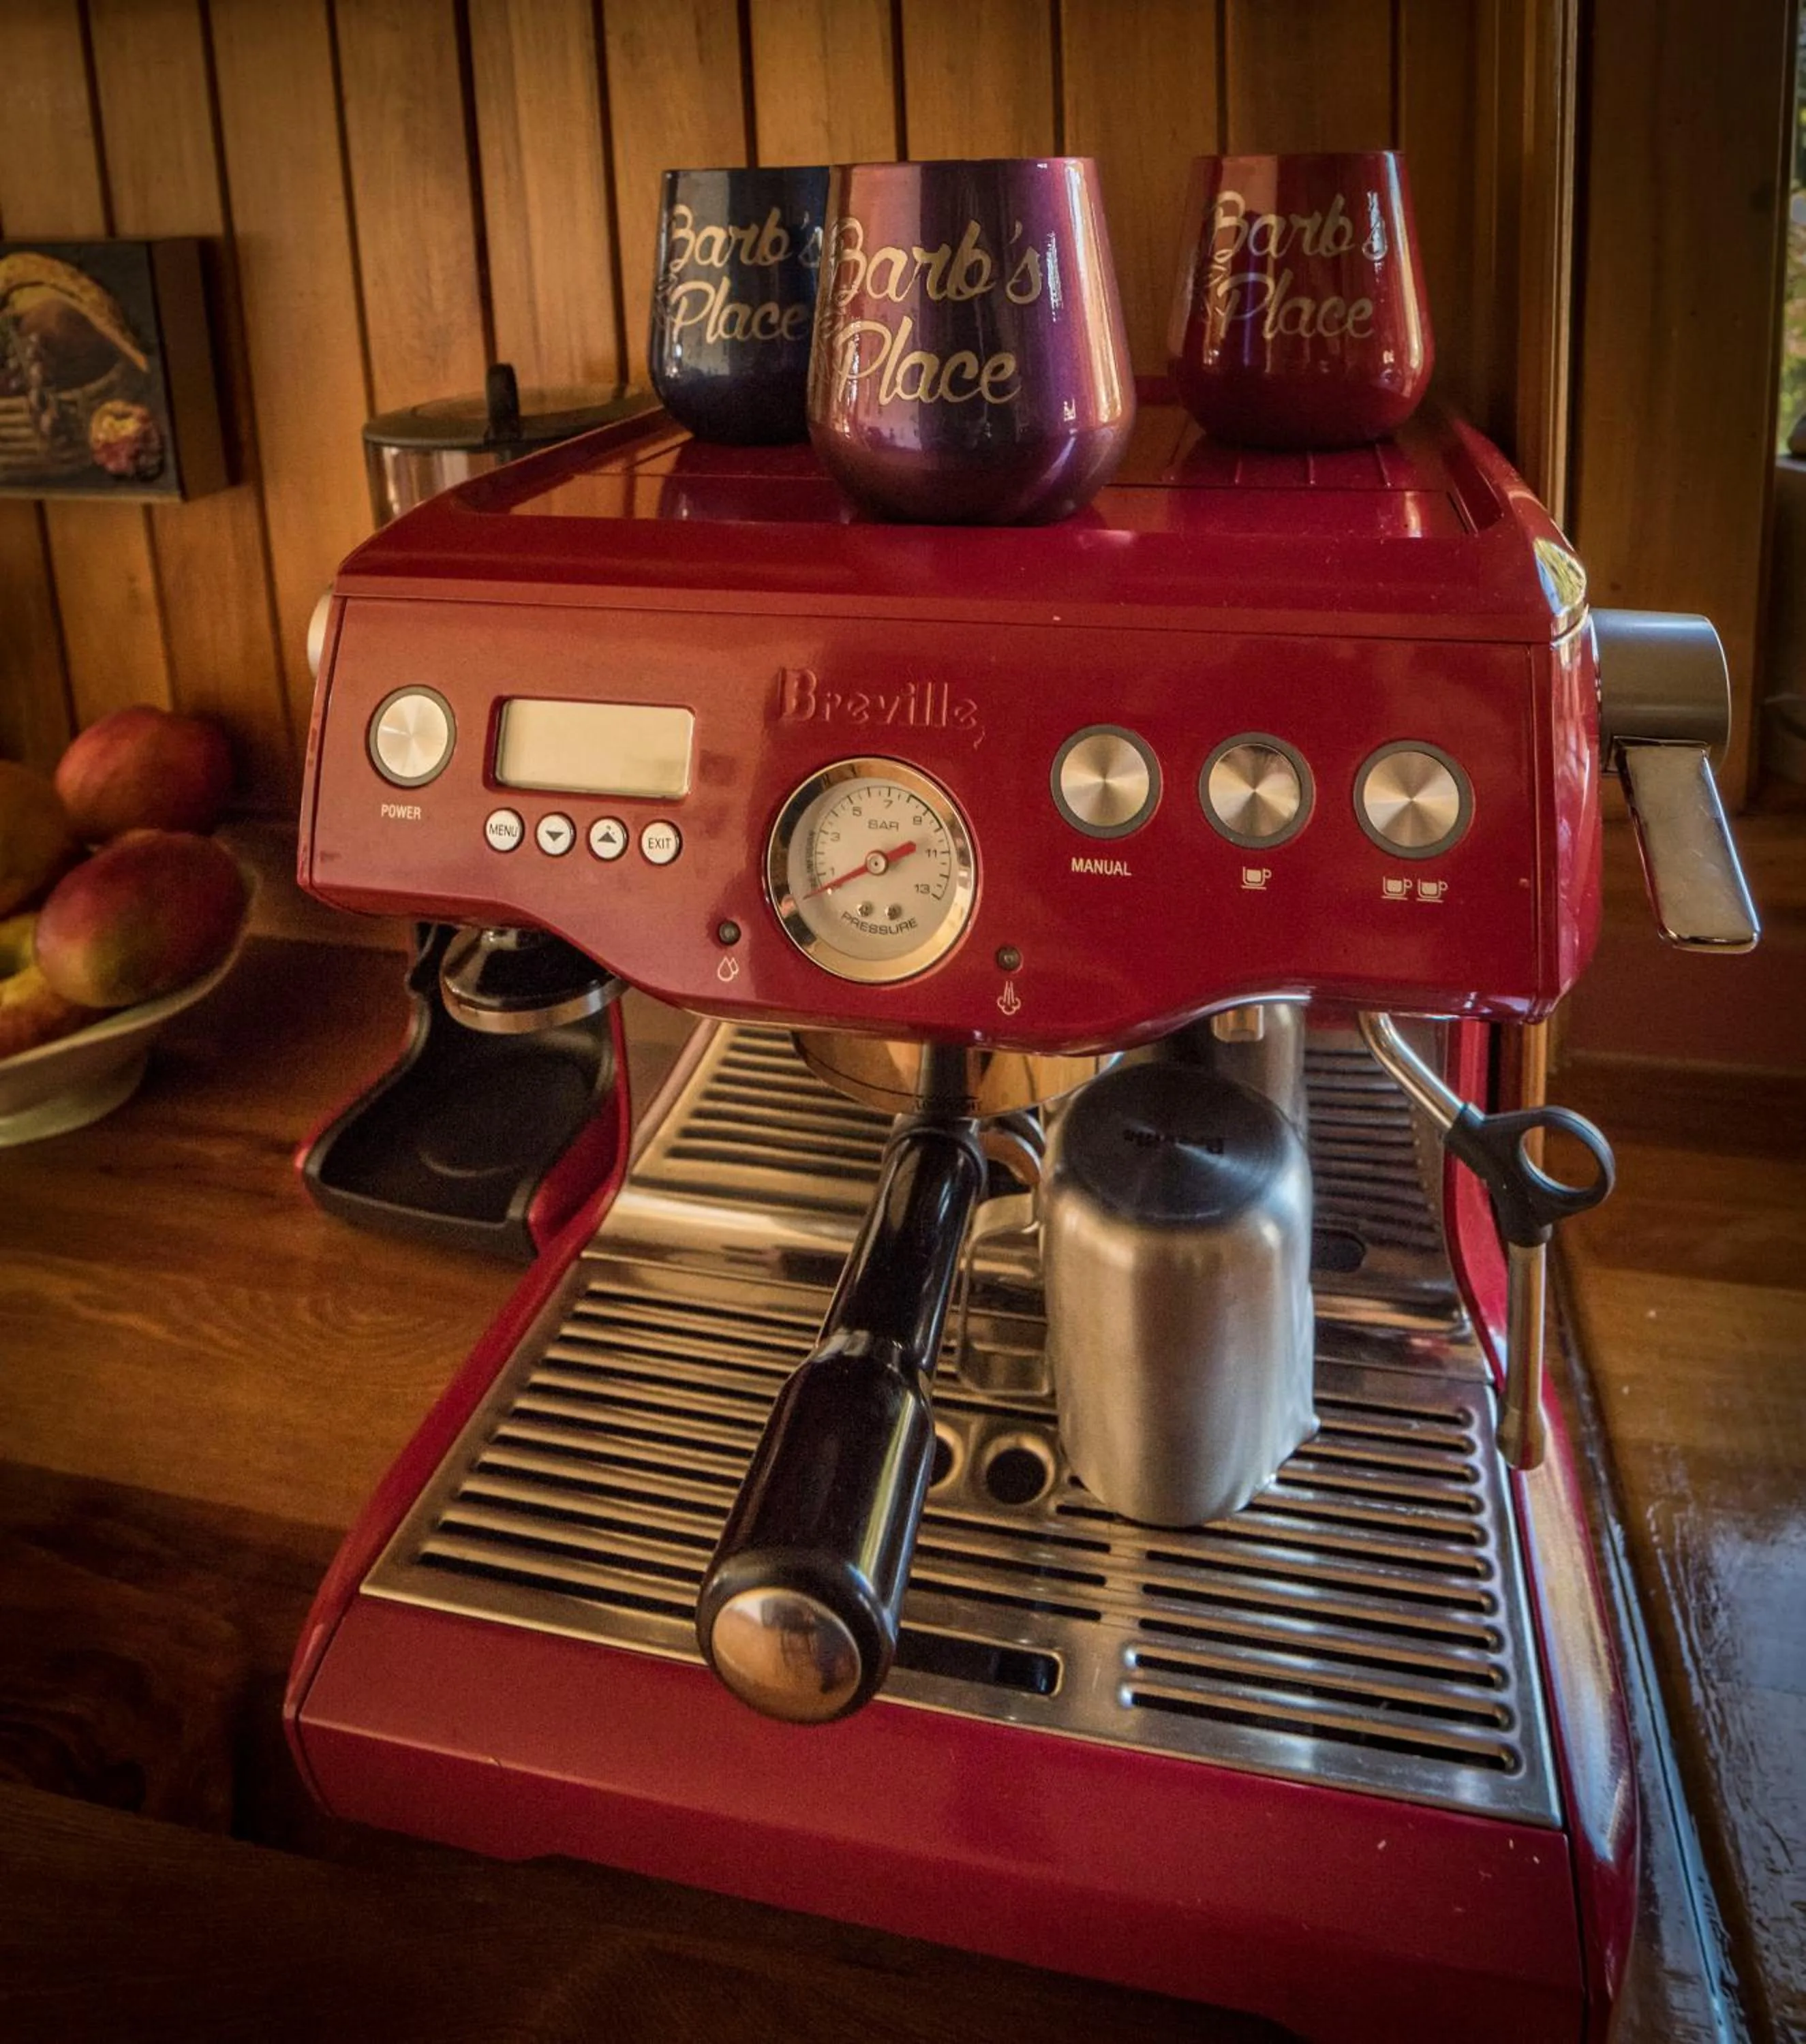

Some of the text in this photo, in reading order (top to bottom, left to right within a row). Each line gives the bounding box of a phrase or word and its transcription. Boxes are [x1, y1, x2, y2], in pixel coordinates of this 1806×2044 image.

[829, 217, 1042, 307] Barb's
[670, 276, 808, 344] Place
[1216, 269, 1373, 339] Place
[834, 316, 1022, 405] Place
[777, 666, 979, 731] Breville
[381, 804, 421, 820] POWER
[884, 799, 893, 809] 7
[489, 823, 519, 839] MENU
[868, 820, 900, 832] BAR
[647, 837, 672, 850] EXIT
[829, 832, 840, 842] 3
[925, 848, 938, 858] 11
[1071, 857, 1132, 876] MANUAL
[914, 884, 931, 895] 13
[840, 911, 918, 935] PRESSURE
